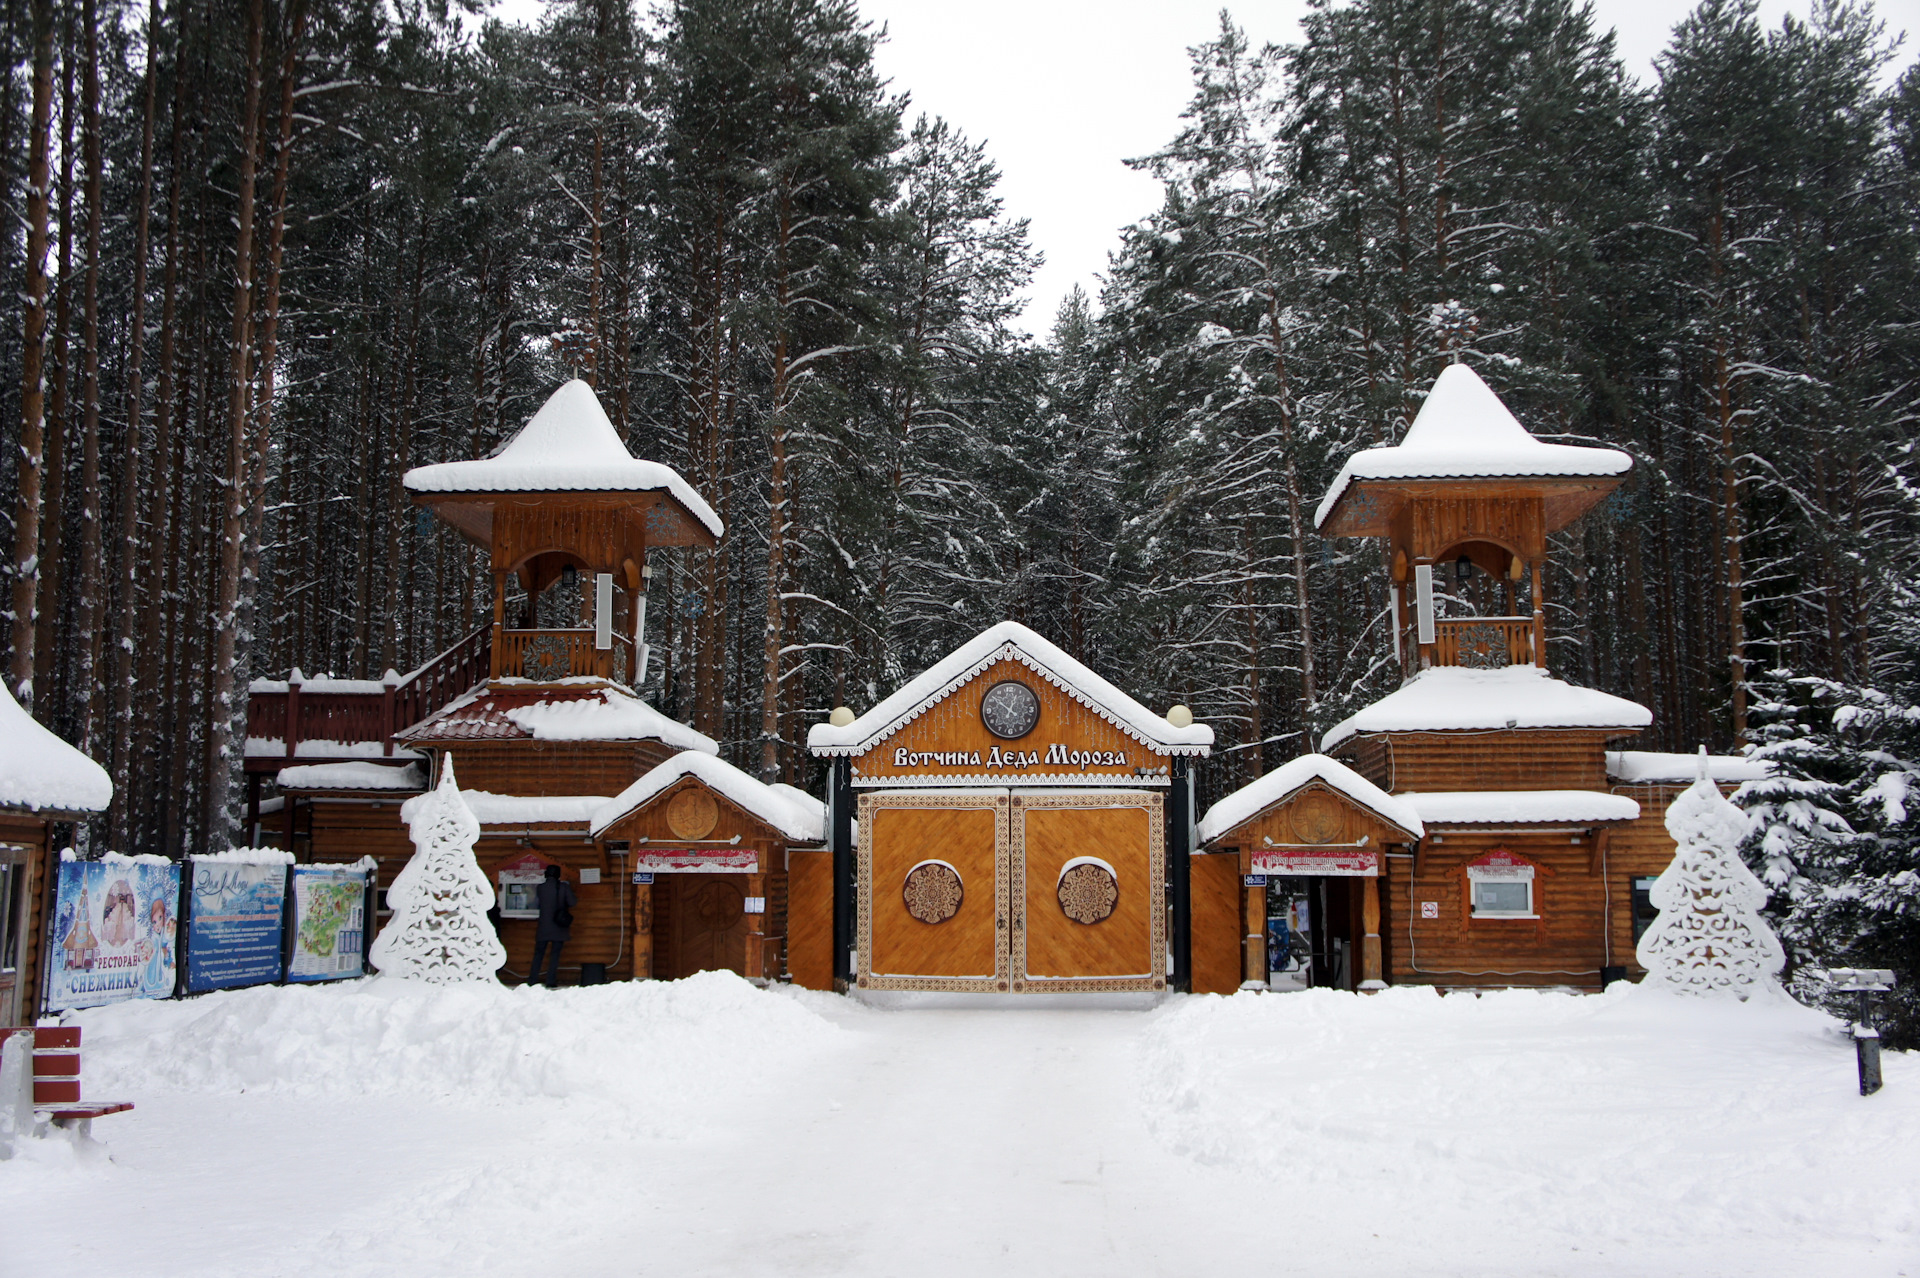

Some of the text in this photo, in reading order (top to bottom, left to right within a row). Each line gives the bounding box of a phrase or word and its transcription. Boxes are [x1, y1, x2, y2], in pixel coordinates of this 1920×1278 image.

[986, 707, 992, 715] 9
[892, 742, 1127, 770] Вотчина Деда Мороза
